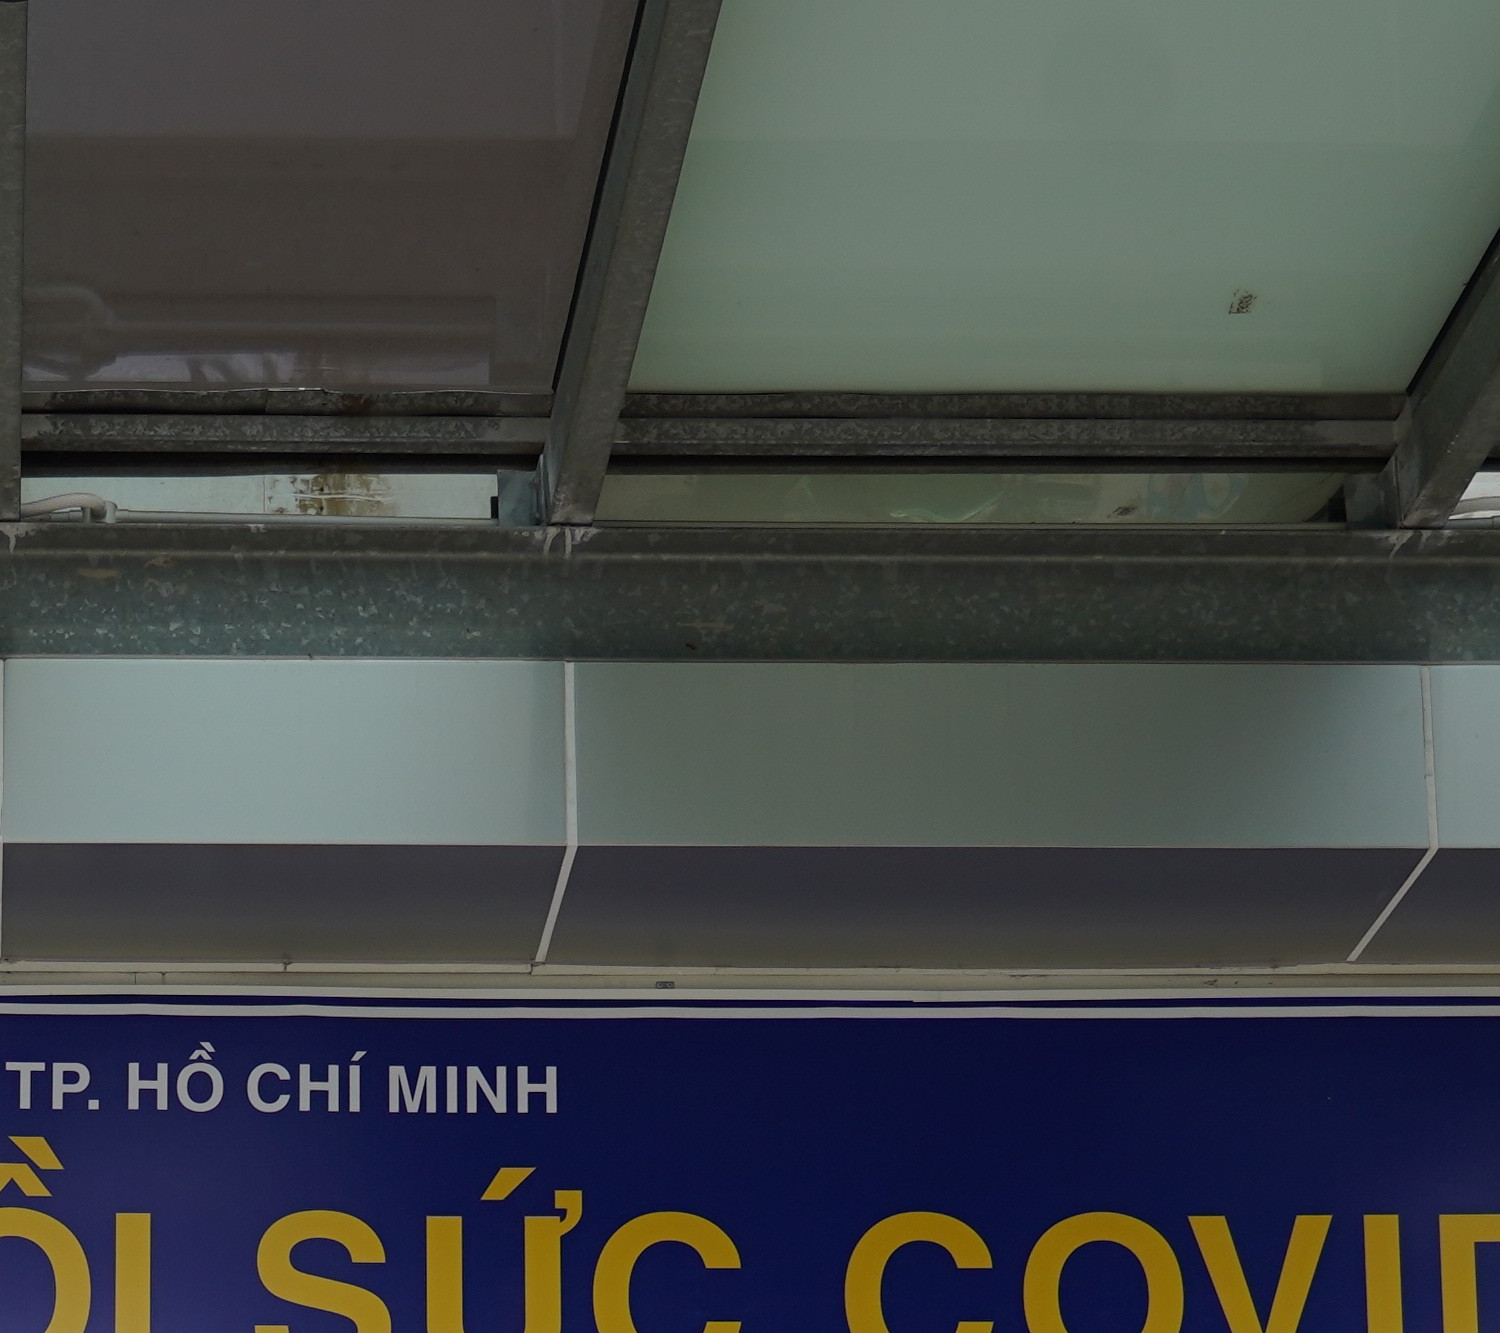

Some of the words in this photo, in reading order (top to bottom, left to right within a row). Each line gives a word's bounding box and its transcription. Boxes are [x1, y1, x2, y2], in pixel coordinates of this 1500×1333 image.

[6, 1063, 100, 1112] TP.
[127, 1042, 225, 1113] HỒ
[246, 1052, 362, 1113] CHÍ
[389, 1064, 557, 1114] MINH
